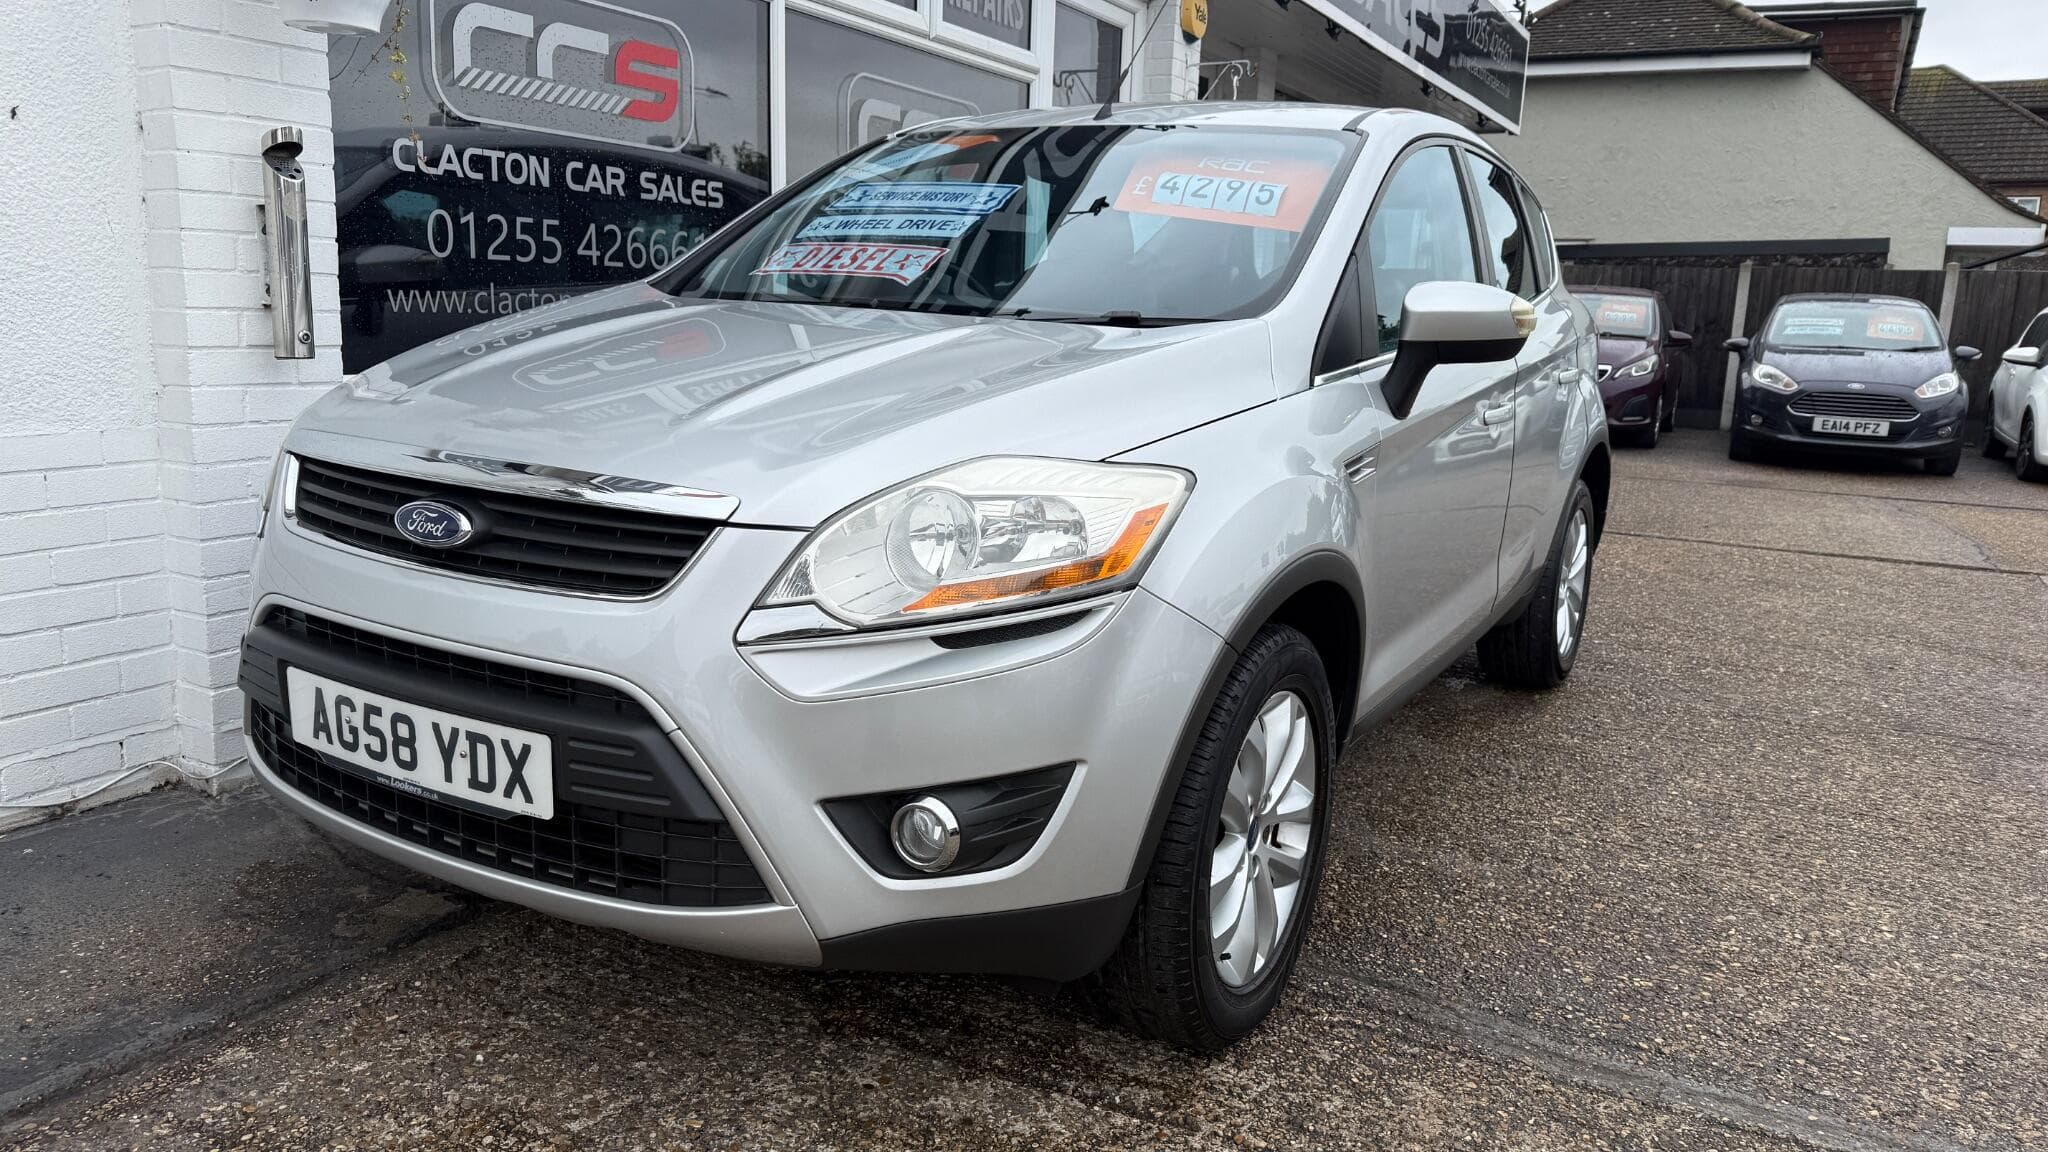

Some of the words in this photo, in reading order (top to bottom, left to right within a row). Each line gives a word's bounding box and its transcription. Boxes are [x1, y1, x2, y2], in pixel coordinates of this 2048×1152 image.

[453, 2, 679, 122] CCS
[392, 138, 550, 188] CLACTON
[565, 161, 625, 197] CAR
[640, 172, 724, 208] SALES
[872, 191, 923, 202] SERVICE
[920, 192, 973, 203] HISTORY
[835, 218, 894, 230] WHEEL
[896, 220, 954, 231] DRIVE
[427, 208, 563, 264] 01255
[577, 223, 705, 271] 42666
[793, 246, 898, 271] DIESEL
[1821, 419, 1850, 432] EA14
[1854, 421, 1881, 434] PFZ
[407, 509, 448, 537] Ford
[313, 686, 418, 772] AG58
[432, 721, 533, 805] YDX
